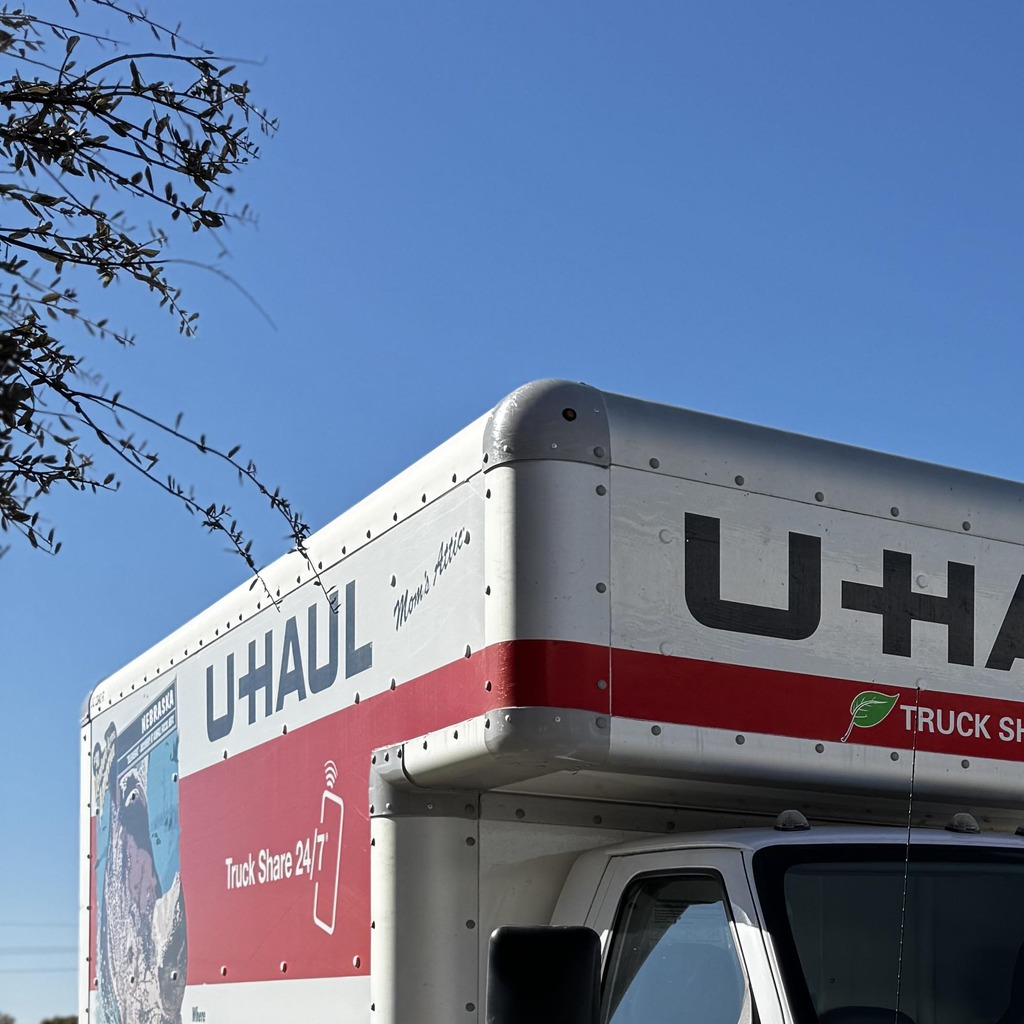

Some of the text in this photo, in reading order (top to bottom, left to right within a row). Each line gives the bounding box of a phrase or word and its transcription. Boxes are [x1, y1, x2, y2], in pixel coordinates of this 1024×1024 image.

[393, 529, 464, 631] Mom's Attic
[205, 580, 373, 743] U-HAUL
[141, 690, 174, 734] NEBRASKA
[900, 704, 991, 739] TRUCK
[225, 853, 255, 889] Truck
[258, 848, 292, 884] Share
